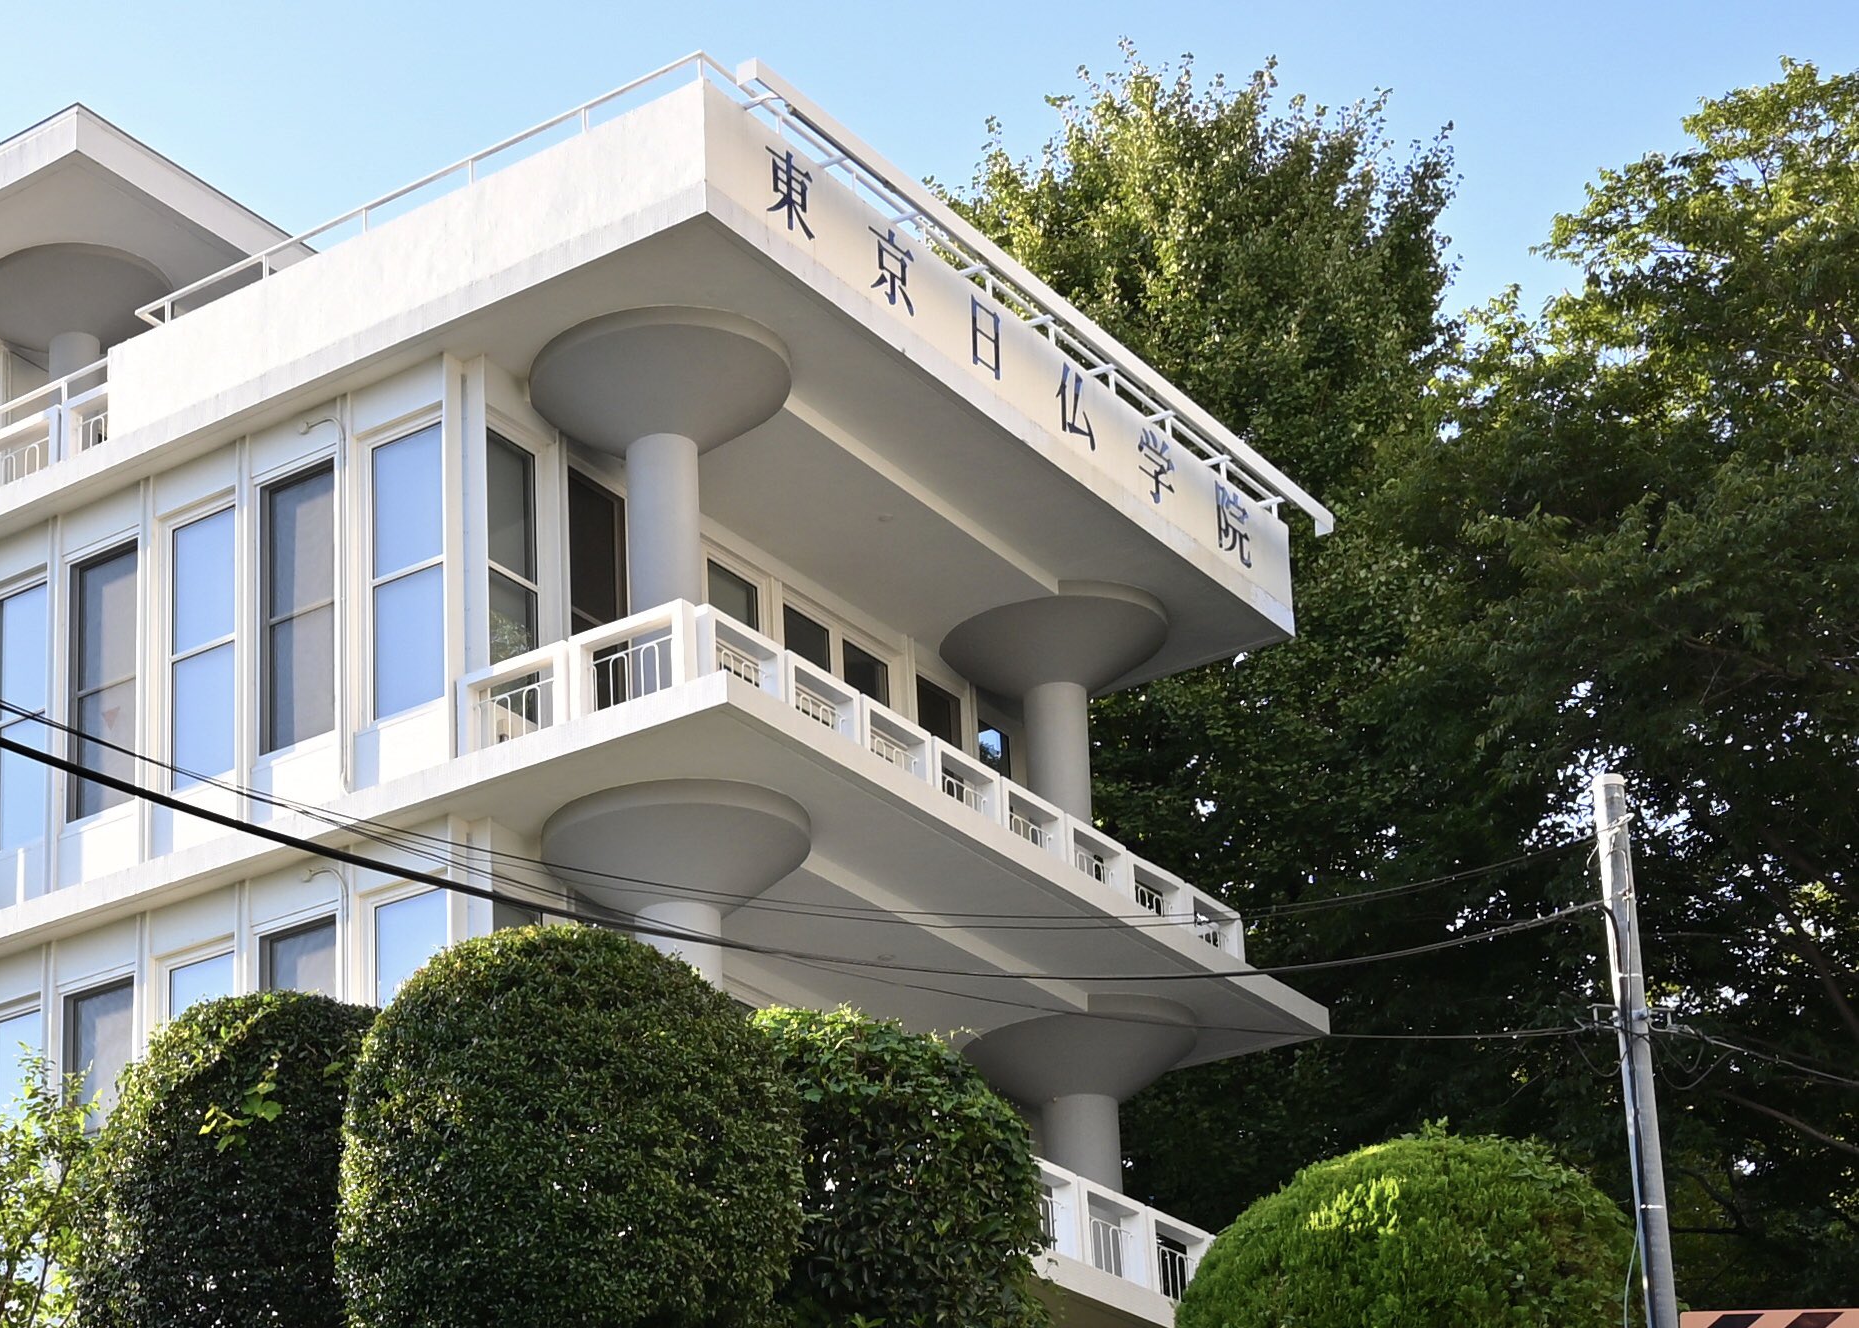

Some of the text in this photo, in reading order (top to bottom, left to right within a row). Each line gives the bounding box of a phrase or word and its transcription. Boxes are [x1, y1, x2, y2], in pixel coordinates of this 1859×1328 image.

[764, 144, 1253, 570] 東京日仏学院
